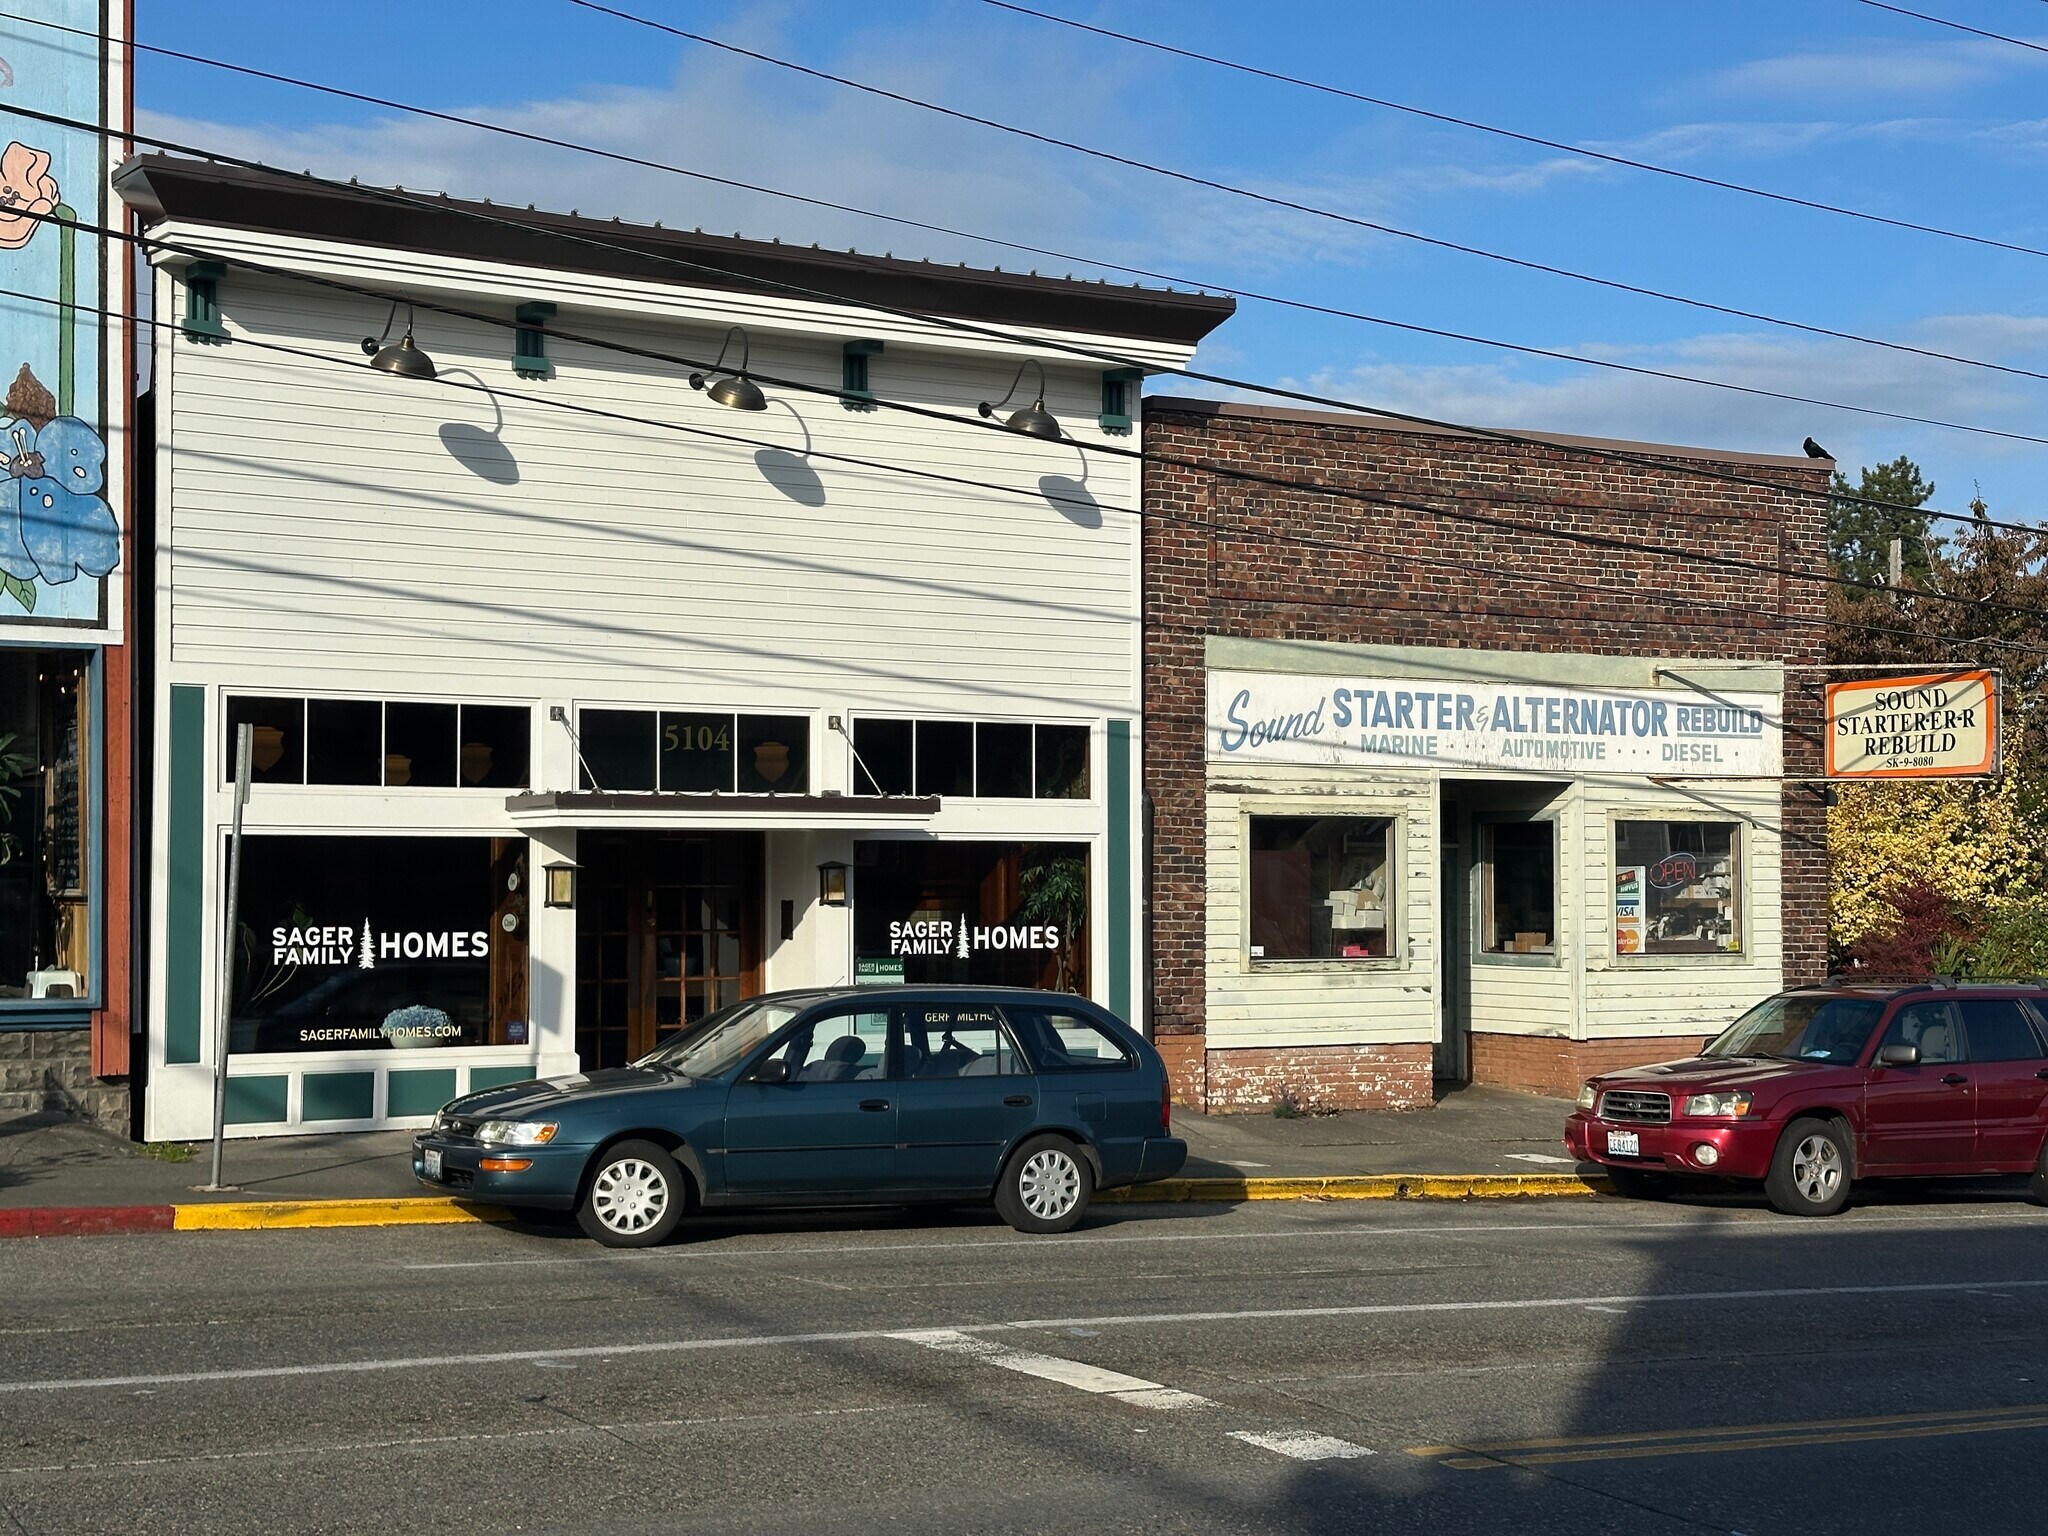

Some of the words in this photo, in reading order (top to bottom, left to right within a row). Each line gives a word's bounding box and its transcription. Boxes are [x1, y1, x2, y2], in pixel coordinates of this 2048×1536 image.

[1875, 688, 1948, 711] SOUND
[1221, 689, 1326, 752] Sound
[1333, 688, 1475, 731] STARTER
[1476, 705, 1488, 733] &
[1490, 696, 1668, 737] ALTERNATOR
[1677, 706, 1763, 734] REBUILD
[664, 724, 730, 752] 5104
[1360, 734, 1438, 756] MARINE
[1501, 738, 1606, 760] AUTOMOTIVE
[1662, 743, 1724, 763] DIESEL
[1864, 733, 1956, 756] REBUILD
[1650, 861, 1695, 882] OPEN
[1617, 906, 1635, 916] VISA
[272, 926, 354, 946] SAGER
[889, 921, 953, 938] SAGER
[973, 925, 1060, 950] HOMES
[380, 931, 489, 958] HOMES
[891, 939, 953, 955] FAMILY
[273, 947, 354, 966] FAMILY
[300, 1025, 462, 1042] SAGERFAMILYHOMES.COM
